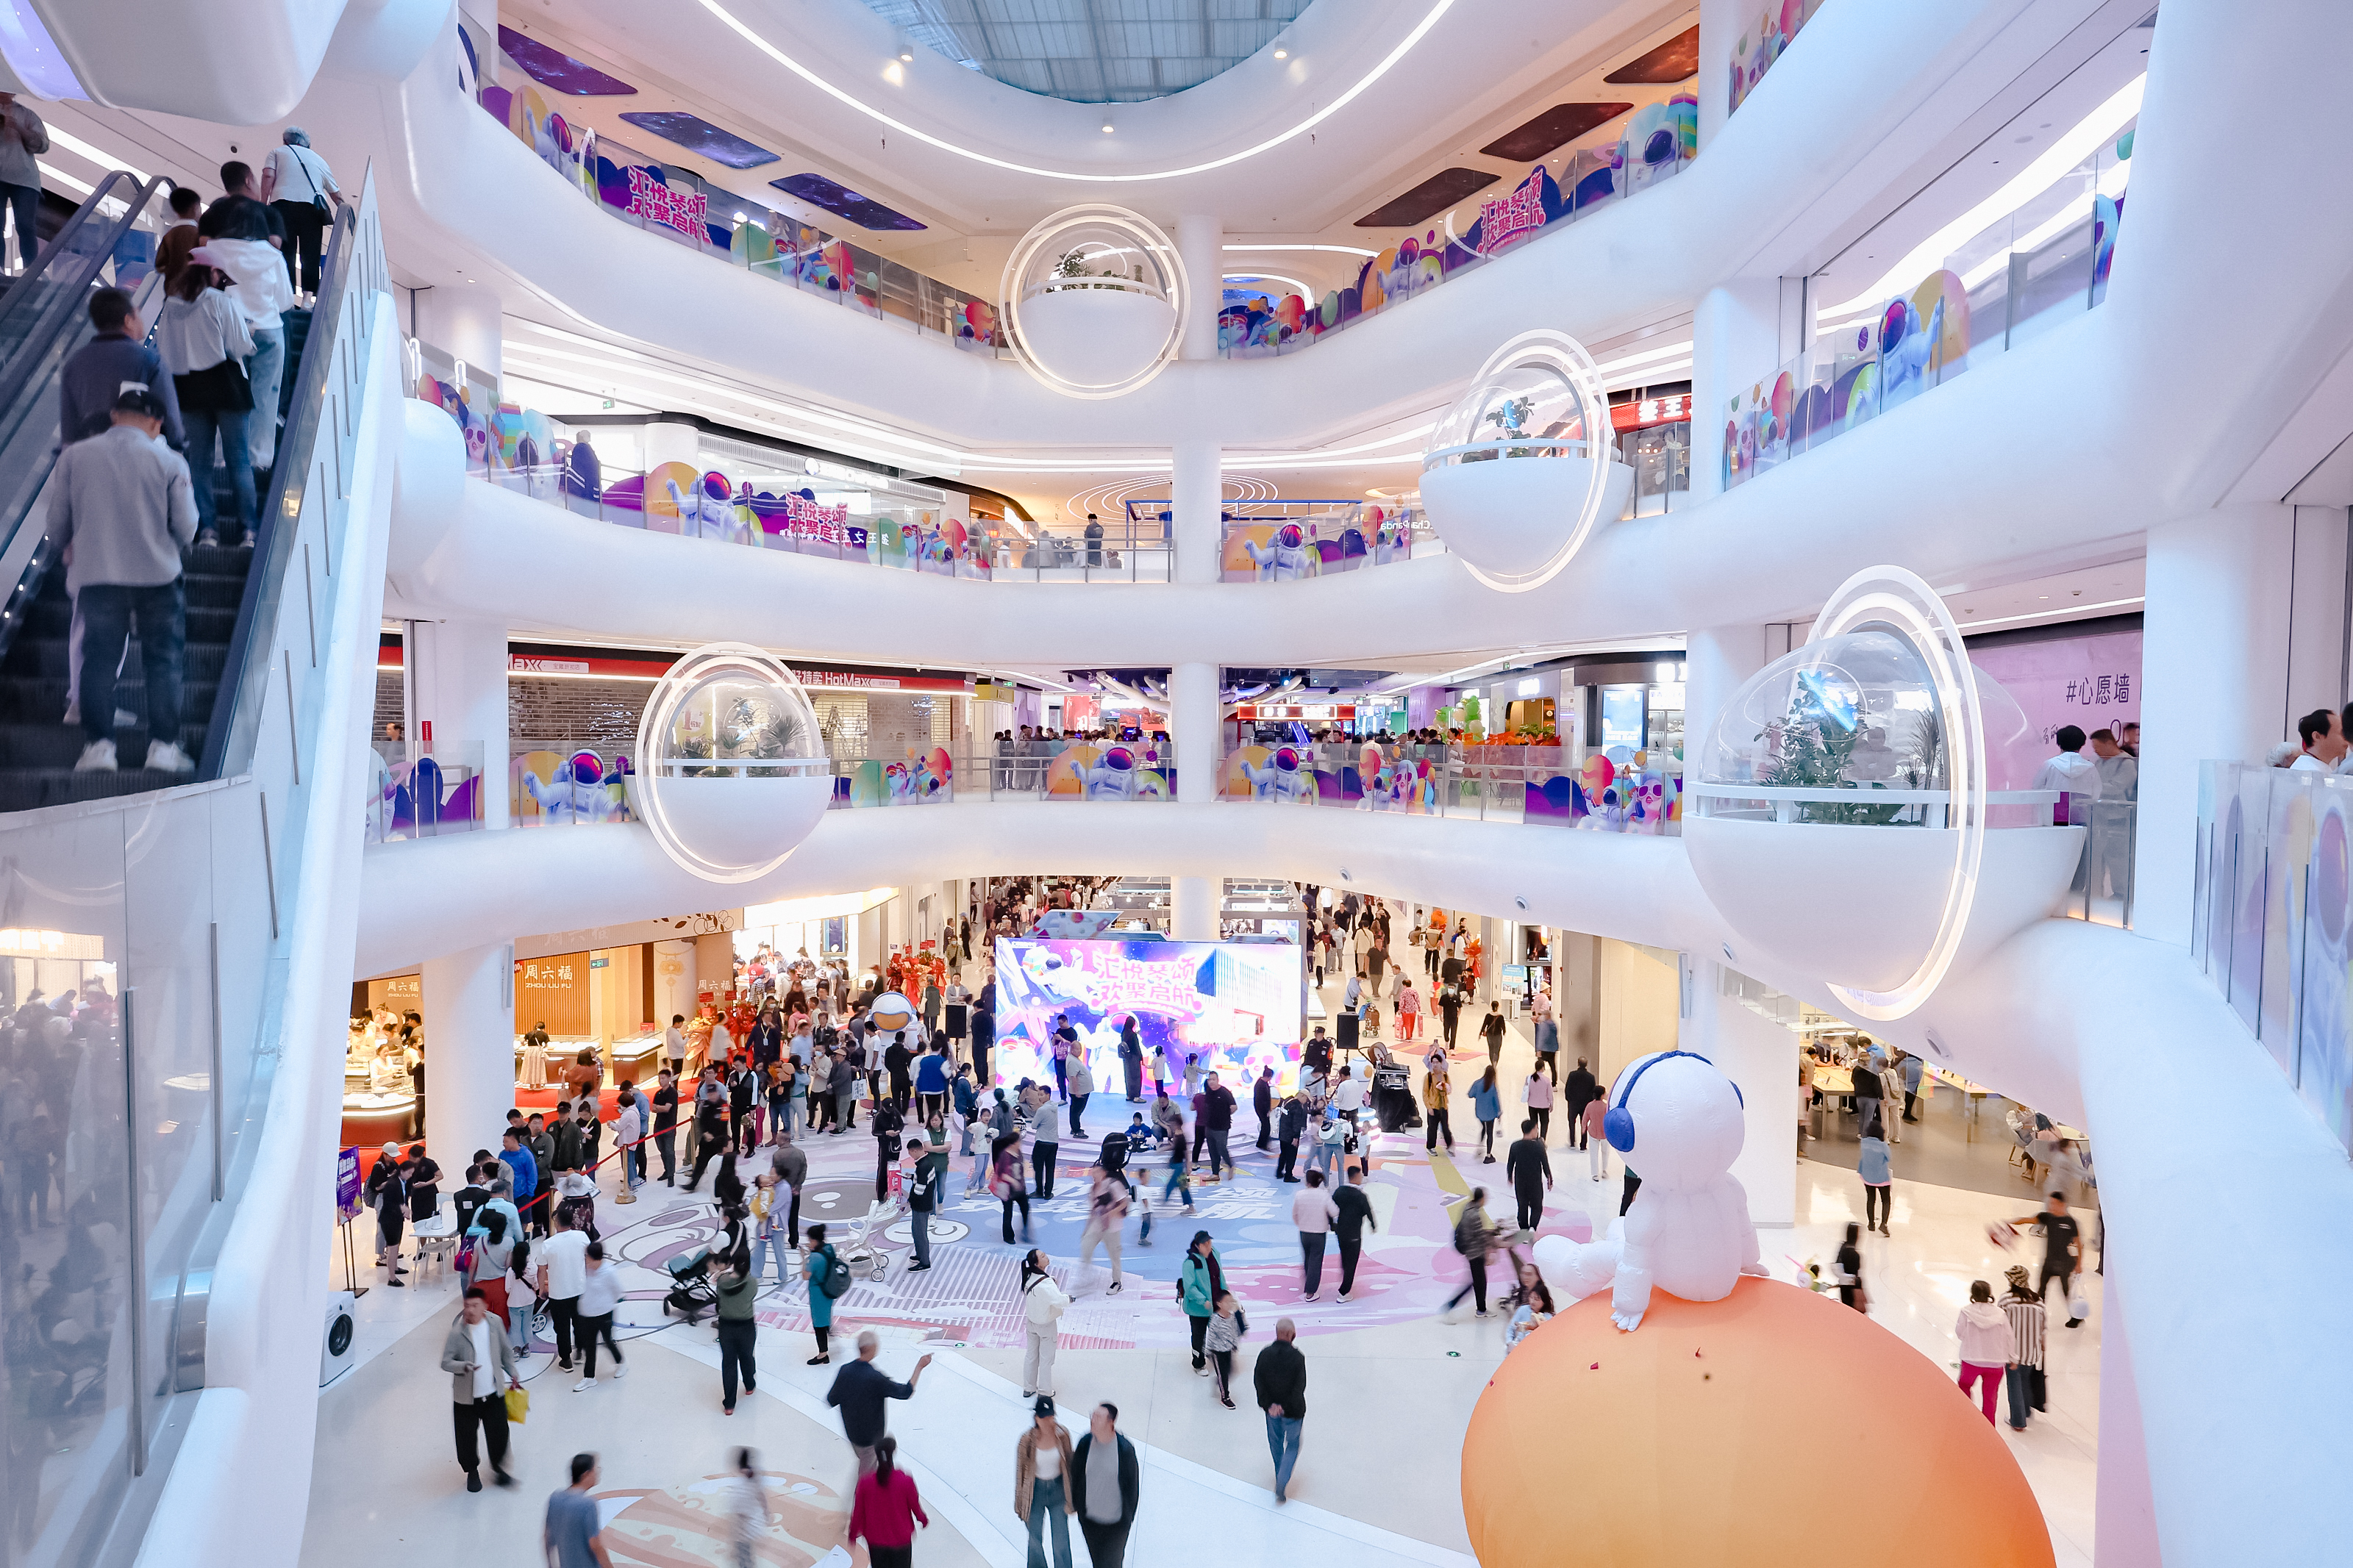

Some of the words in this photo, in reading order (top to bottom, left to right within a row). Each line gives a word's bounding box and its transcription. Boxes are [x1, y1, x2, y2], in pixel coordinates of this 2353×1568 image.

[627, 162, 707, 222] 汇悦琴颂
[1480, 168, 1543, 229] 汇悦琴颂
[626, 196, 713, 246] 欢聚启航
[1477, 200, 1546, 254] 欢聚启航
[1638, 397, 1692, 423] 签王
[785, 491, 848, 525] 汇悦琴颂
[2066, 673, 2130, 705] #心愿墙
[524, 964, 573, 980] 周六福
[1098, 956, 1195, 981] 汇悦琴颂
[387, 981, 419, 992] 周六福
[697, 979, 731, 990] 周六福
[1091, 981, 1203, 1008] 欢聚启航
